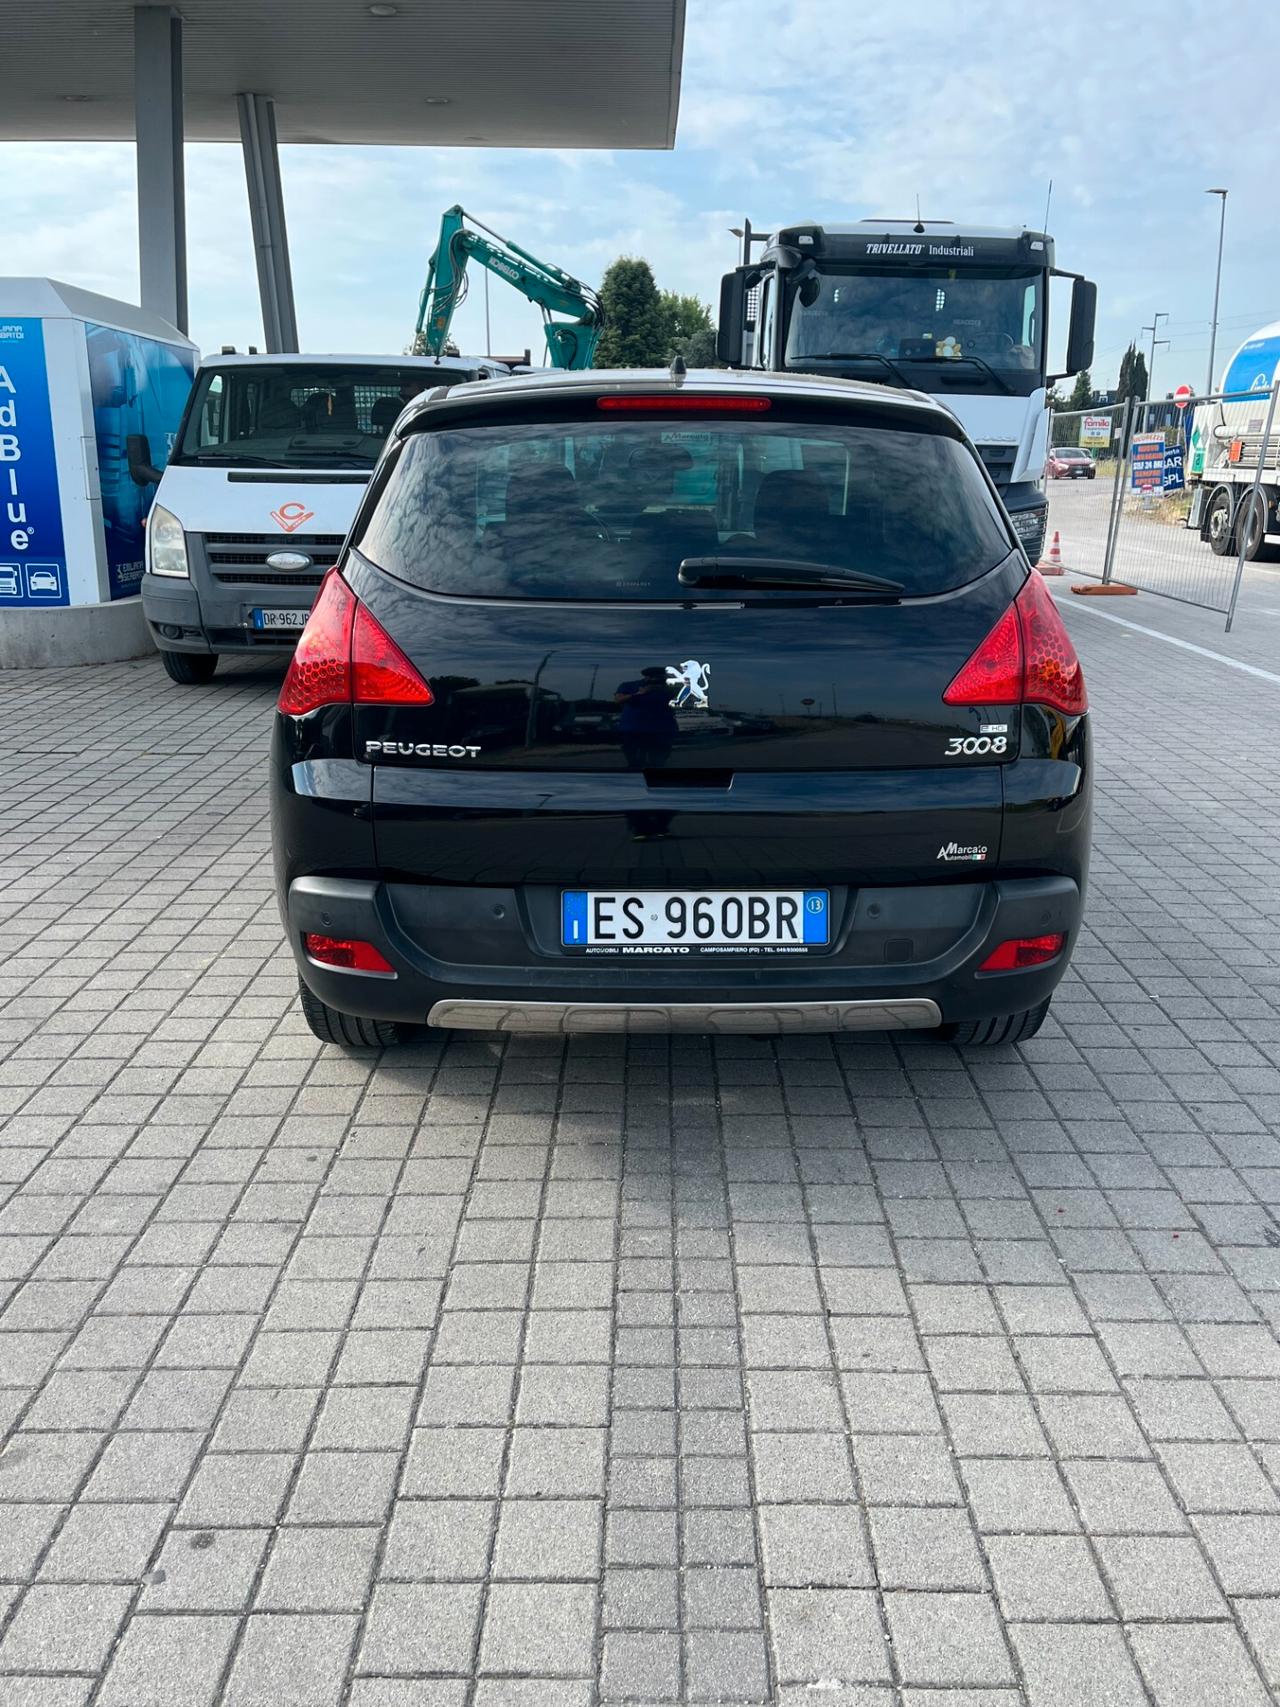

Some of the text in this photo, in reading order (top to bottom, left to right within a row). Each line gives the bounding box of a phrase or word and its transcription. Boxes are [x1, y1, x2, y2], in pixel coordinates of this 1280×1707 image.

[866, 243, 974, 257] TRIVELLATO Industriali
[263, 613, 276, 625] DR
[365, 740, 482, 758] PEUGEOT
[944, 736, 1008, 756] 3008
[594, 896, 644, 940] ES
[664, 896, 799, 940] 960BR
[622, 946, 690, 954] MARCATO
